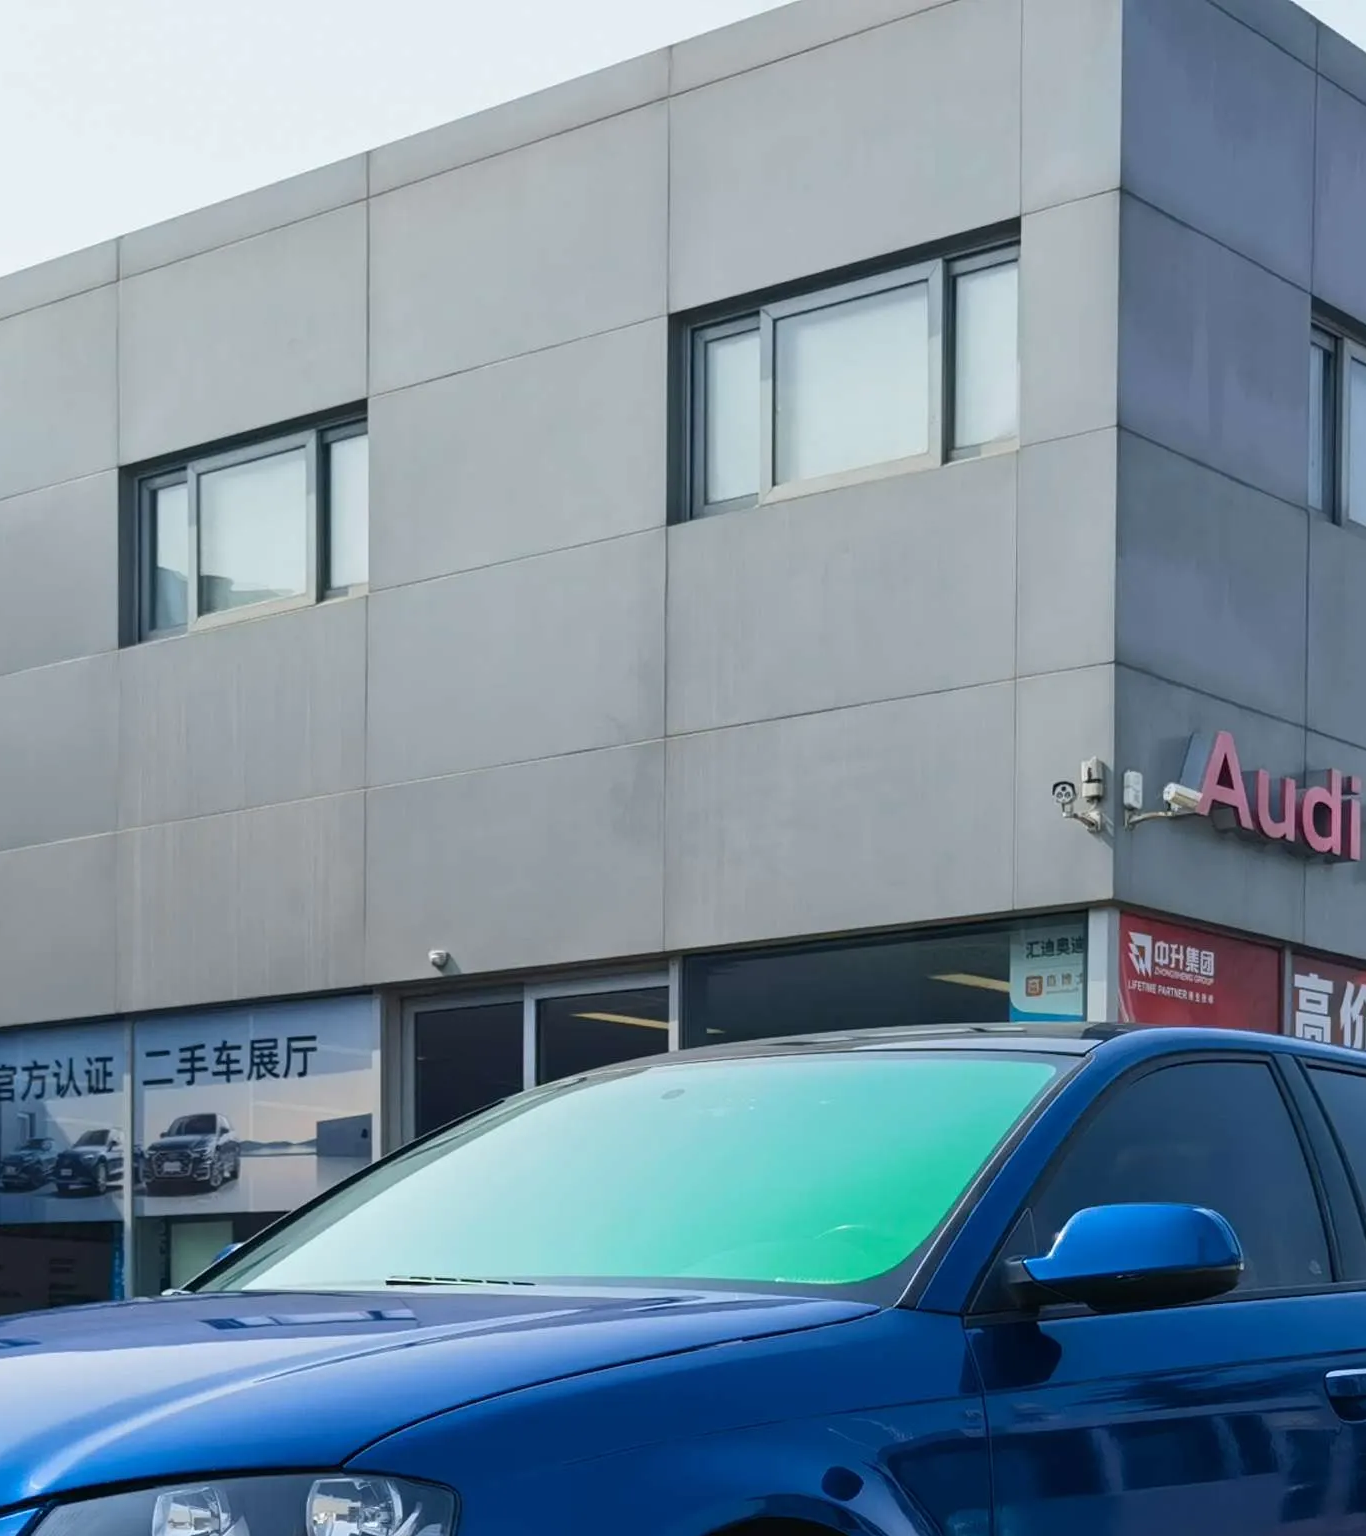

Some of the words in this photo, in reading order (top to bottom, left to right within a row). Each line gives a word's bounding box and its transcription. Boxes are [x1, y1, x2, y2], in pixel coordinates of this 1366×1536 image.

[1197, 731, 1361, 862] Audi
[1154, 940, 1215, 976] 中升集团
[1158, 984, 1187, 999] PARTNER
[142, 1034, 319, 1087] 二手车展厅
